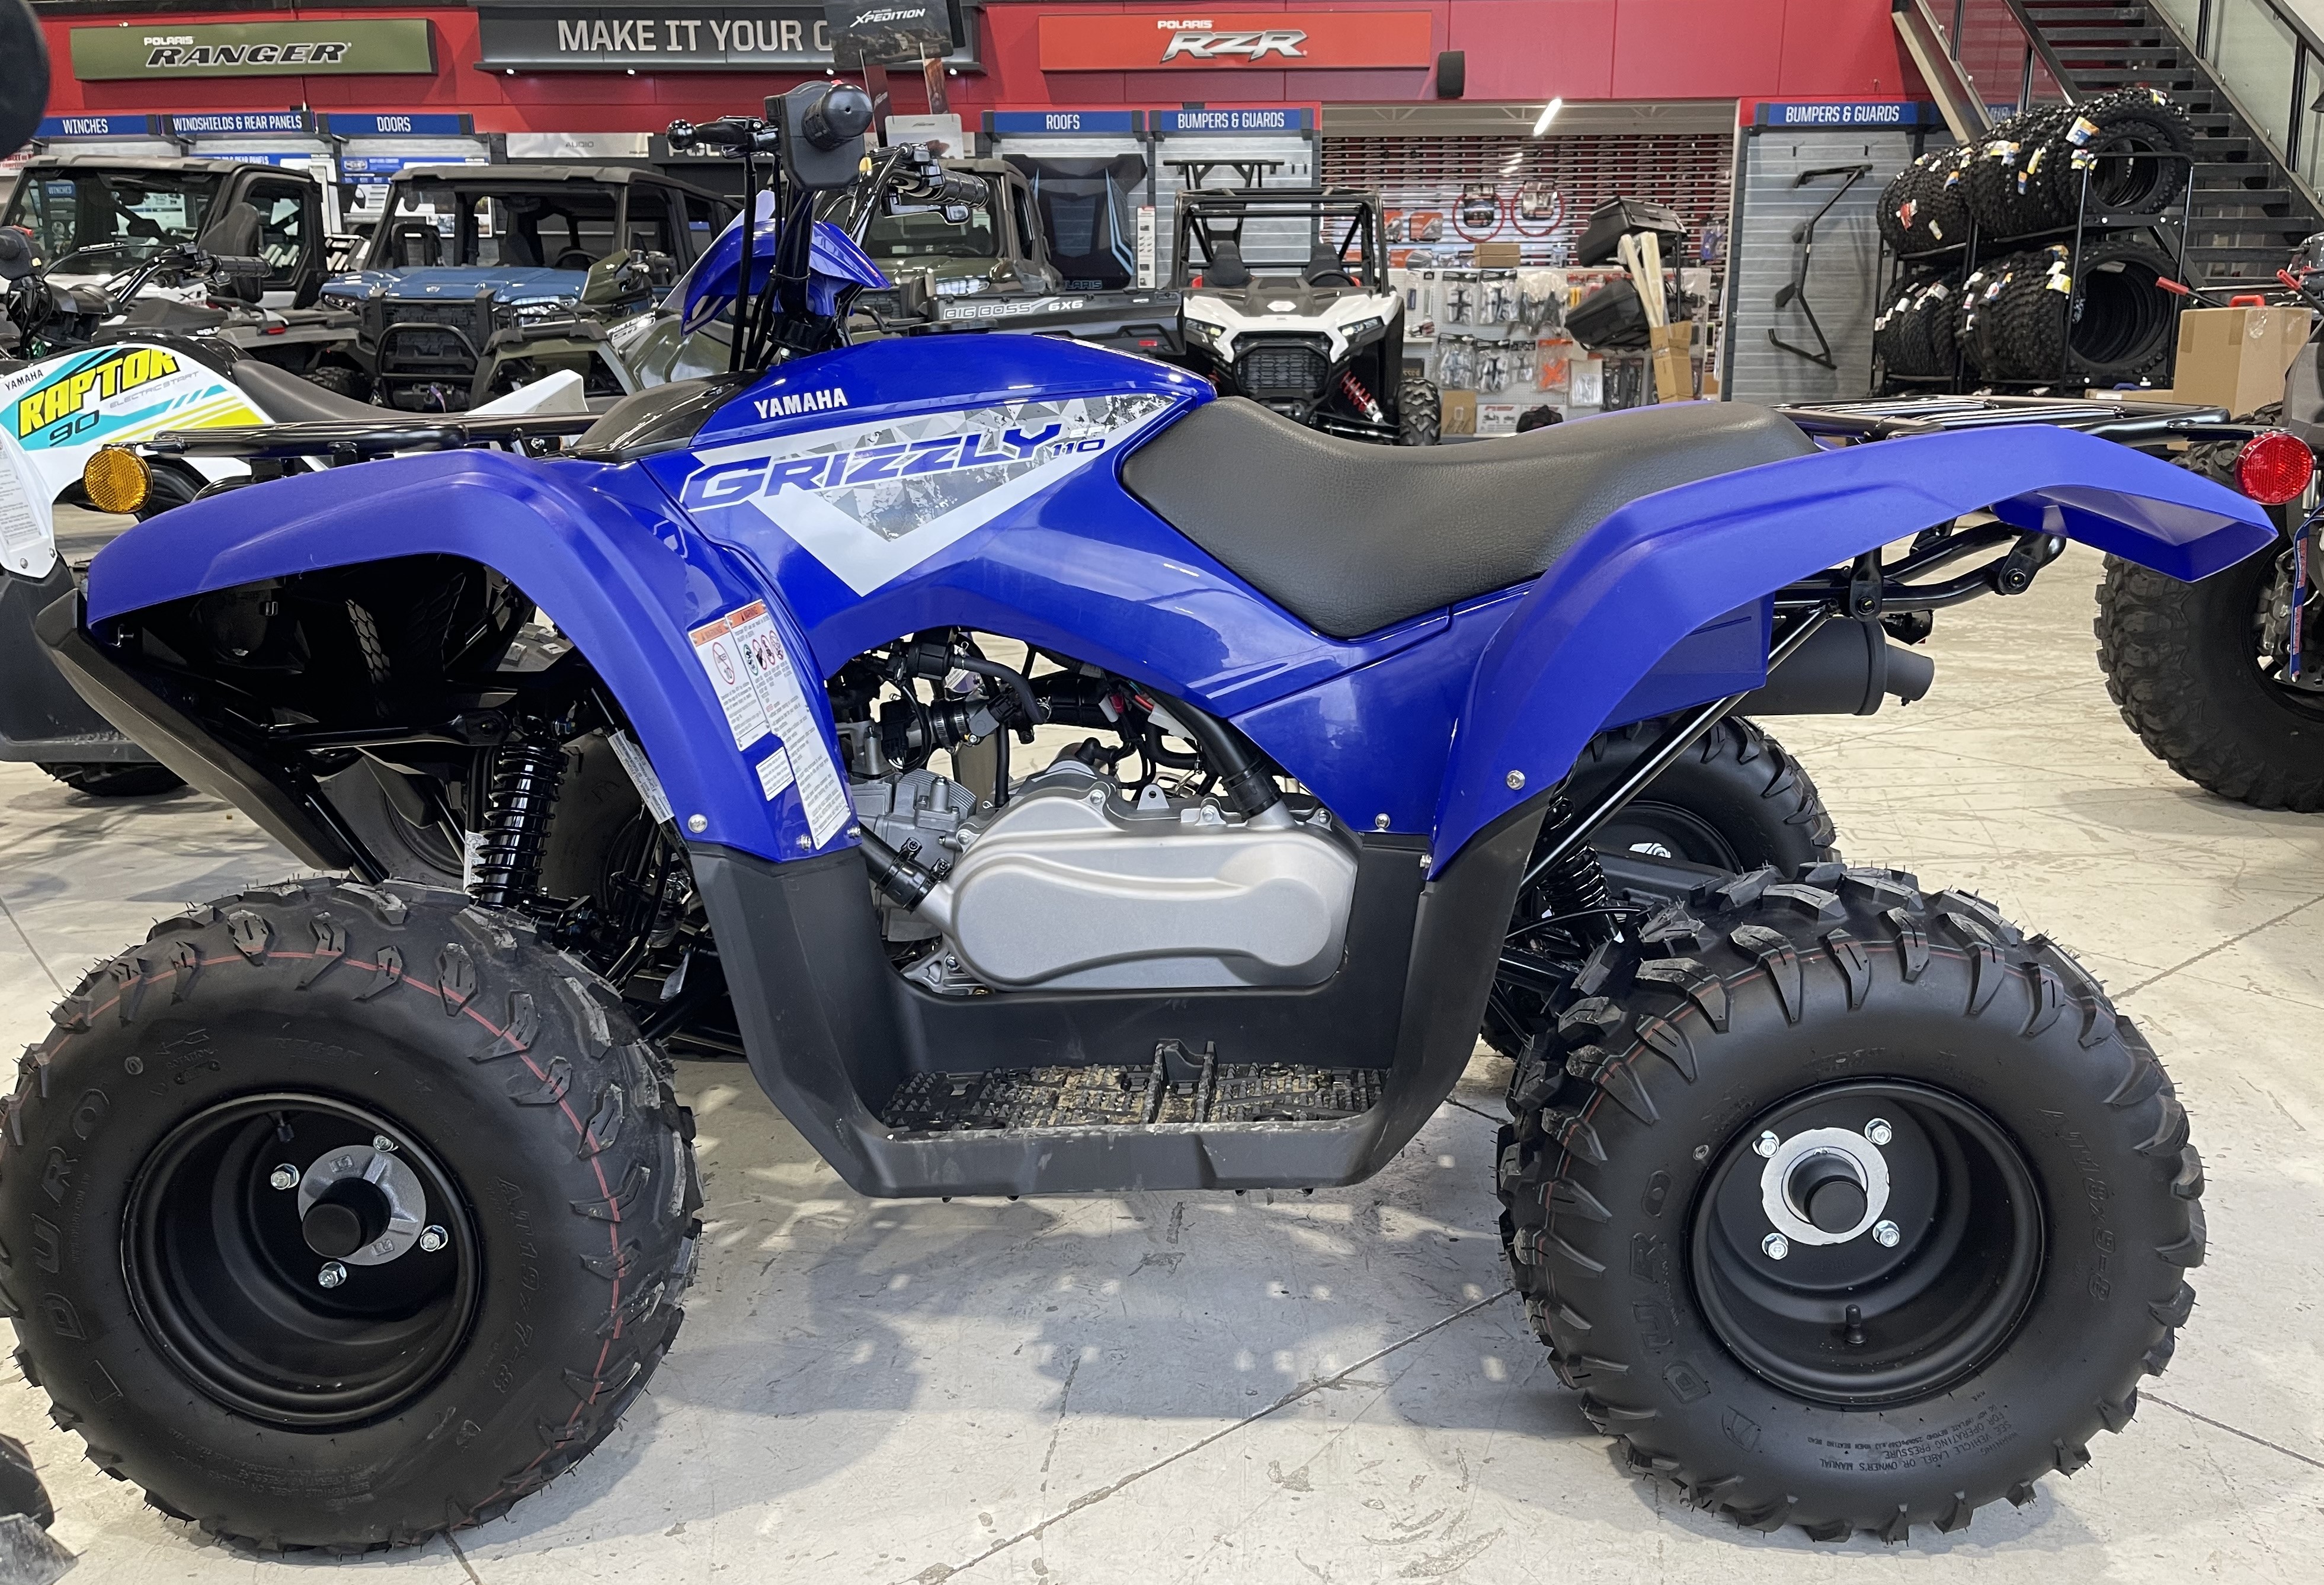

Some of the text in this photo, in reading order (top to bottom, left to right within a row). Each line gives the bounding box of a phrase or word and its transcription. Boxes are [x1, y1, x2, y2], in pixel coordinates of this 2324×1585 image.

[850, 8, 926, 27] XPEDITION
[1157, 20, 1214, 29] POLARIS
[144, 36, 194, 46] POLARIS
[558, 20, 656, 52] MAKE
[666, 20, 698, 52] IT
[709, 20, 802, 52] YOUR
[1160, 30, 1308, 63] RZR
[146, 42, 348, 68] RANGER
[173, 115, 302, 131] WINDSHIELDS & REAR PANELS
[376, 116, 411, 132] DOORS
[1046, 114, 1080, 130] ROOFS
[1177, 111, 1285, 129] BUMPERS & GUARDS
[1785, 105, 1900, 123] BUMPERS & GUARDS
[62, 119, 108, 134] WINCHES
[1063, 280, 1103, 290] LARIS
[943, 306, 976, 319] BIG
[978, 302, 1033, 318] BOSS
[5, 369, 44, 391] YAMAHA
[110, 371, 199, 409] ELECTRIC START
[18, 348, 181, 440] RAPTOR
[754, 388, 848, 420] YAMAHA
[49, 409, 100, 447] 90
[1069, 425, 1111, 438] EFI
[1051, 438, 1106, 459] 110
[679, 423, 1062, 513] GRIZZLY
[31, 1088, 110, 1341] DURO
[1883, 1411, 2005, 1459] FOR OPERATING PRESSURE
[1819, 1420, 2012, 1472] SEE VEHICLE LABEL OR OWNER'S MANUAL
